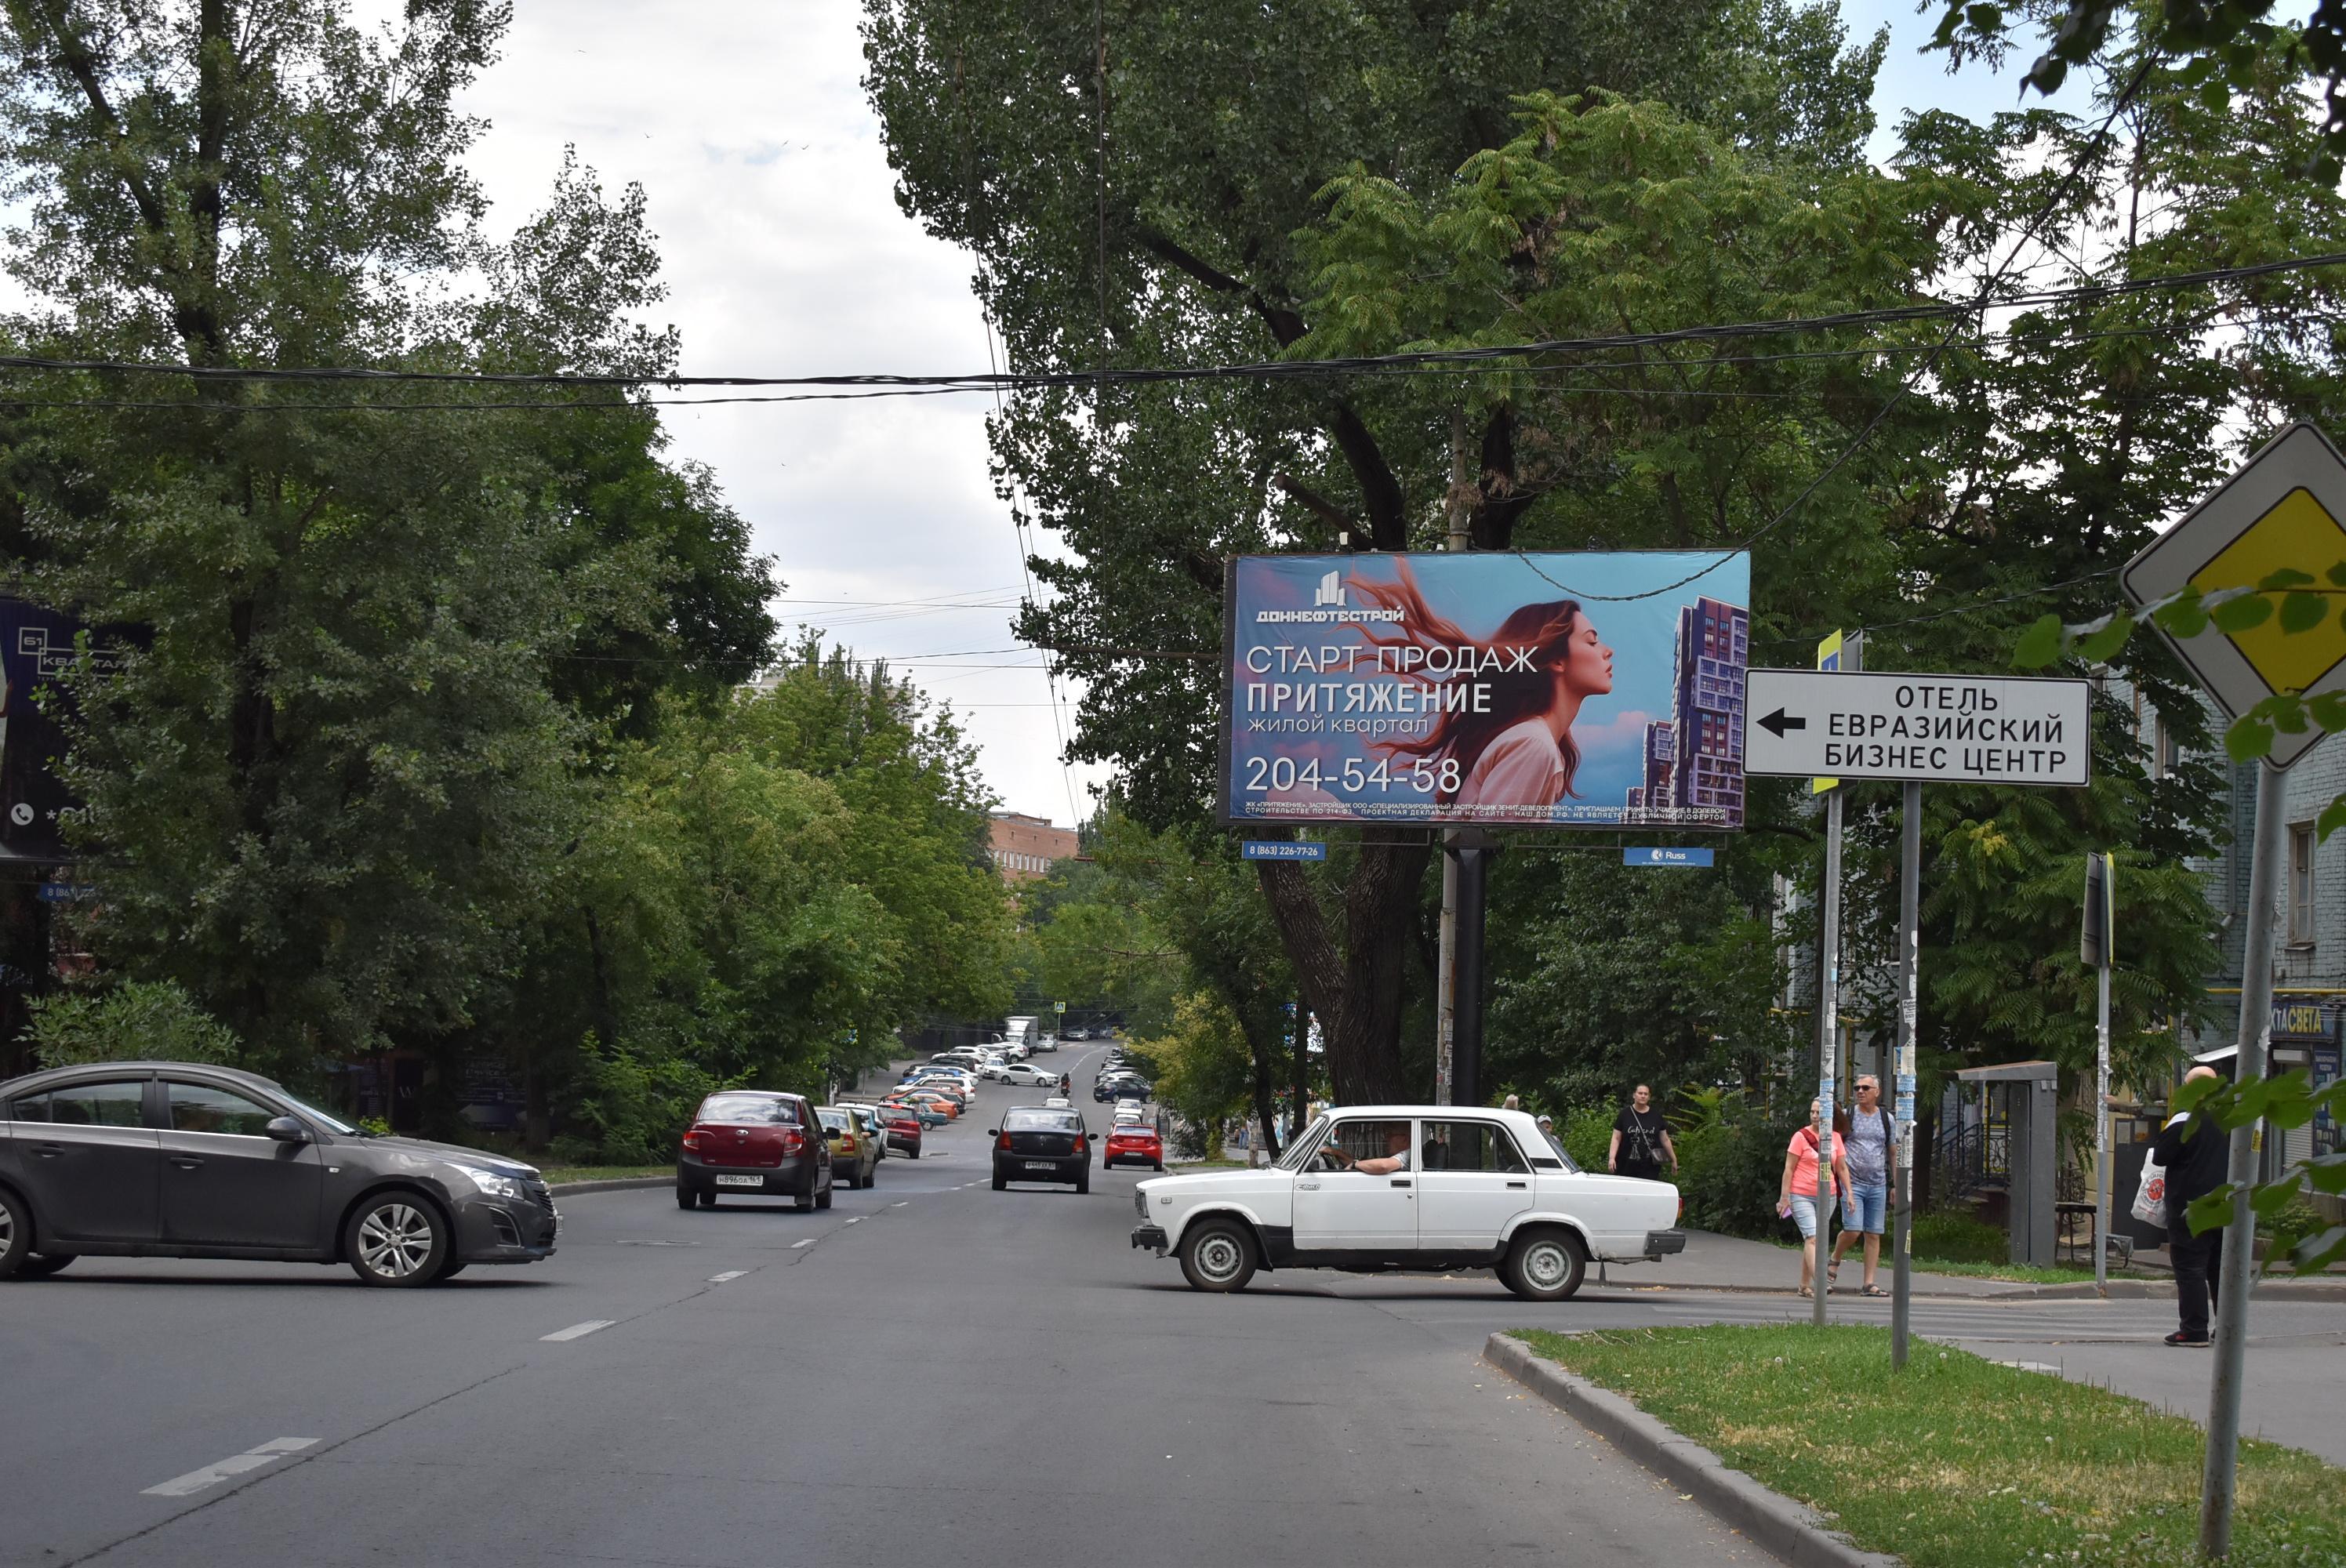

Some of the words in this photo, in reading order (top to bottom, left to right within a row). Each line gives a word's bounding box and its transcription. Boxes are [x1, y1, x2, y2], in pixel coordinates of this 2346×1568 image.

[1256, 606, 1404, 622] ДОННЕФТЕСТРОЙ
[42, 656, 127, 670] КВАТАЛ
[1246, 645, 1363, 673] СТАРТ
[1378, 646, 1539, 678] ПРОДАЖ
[1247, 683, 1492, 713] ПРИТЯЖЕНИЕ
[1895, 684, 1998, 711] ОТЕЛЬ
[1247, 713, 1324, 733] жилой
[1331, 717, 1429, 737] квартал
[1828, 710, 2063, 743] ЕВРАЗИЙСКИЙ
[1825, 743, 1948, 770] БИЗНЕС
[1963, 748, 2066, 776] ЦЕНТР
[1245, 757, 1461, 793] 204-54-58
[1249, 846, 1255, 855] 8
[1257, 845, 1277, 856] (863)
[1280, 847, 1318, 856] 226-77-26
